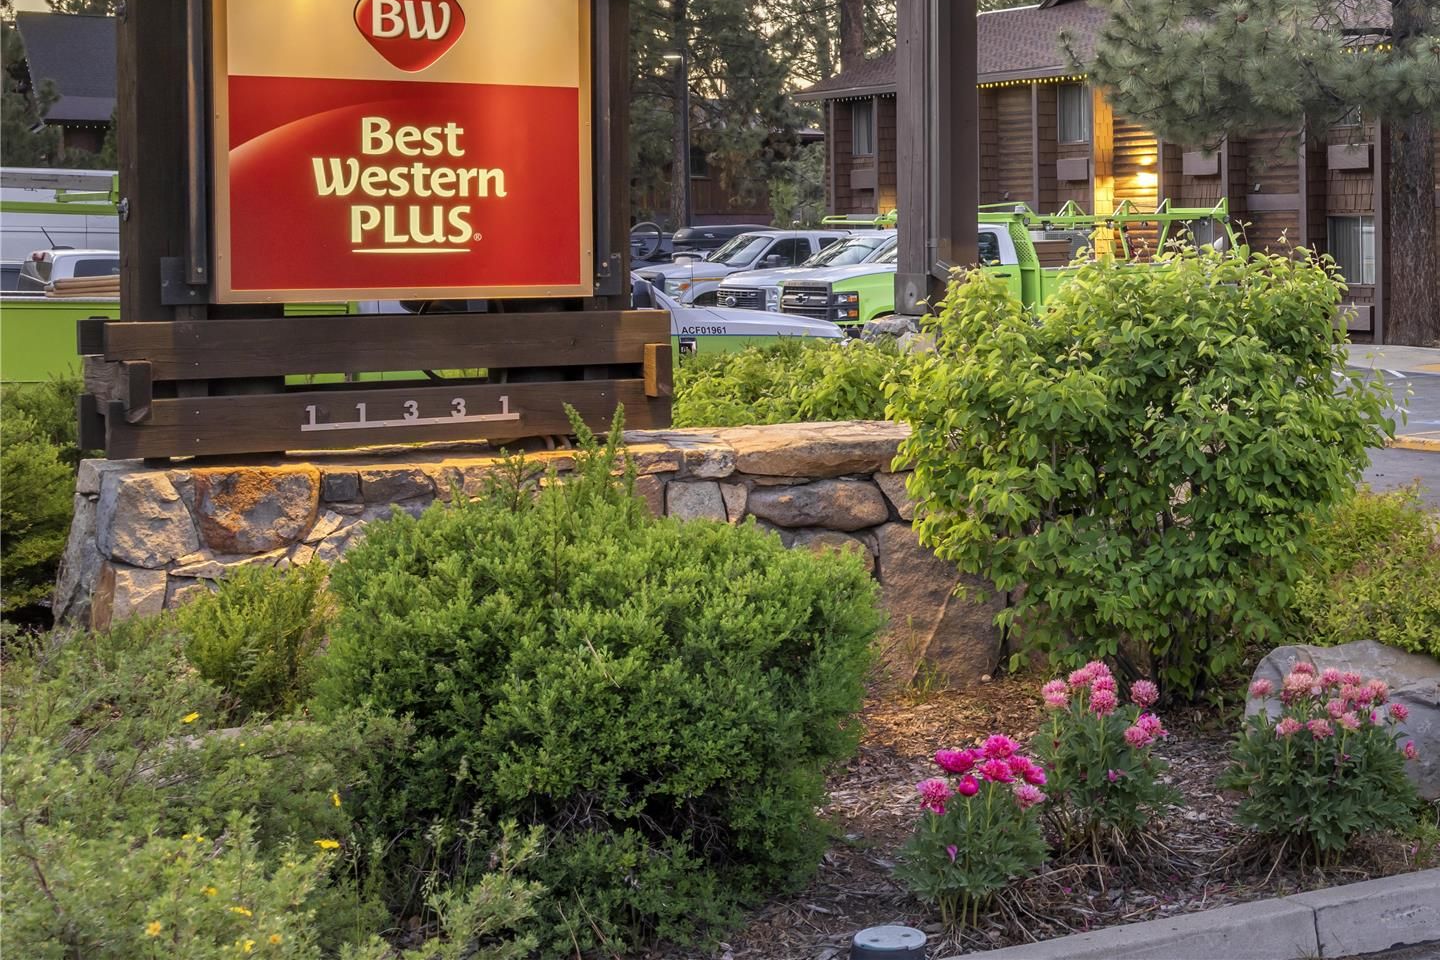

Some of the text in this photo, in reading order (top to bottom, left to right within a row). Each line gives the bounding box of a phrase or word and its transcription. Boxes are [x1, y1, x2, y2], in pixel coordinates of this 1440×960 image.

[361, 117, 465, 156] Best
[312, 158, 508, 198] Western
[681, 326, 727, 334] ACF01961
[304, 396, 511, 425] 11331
